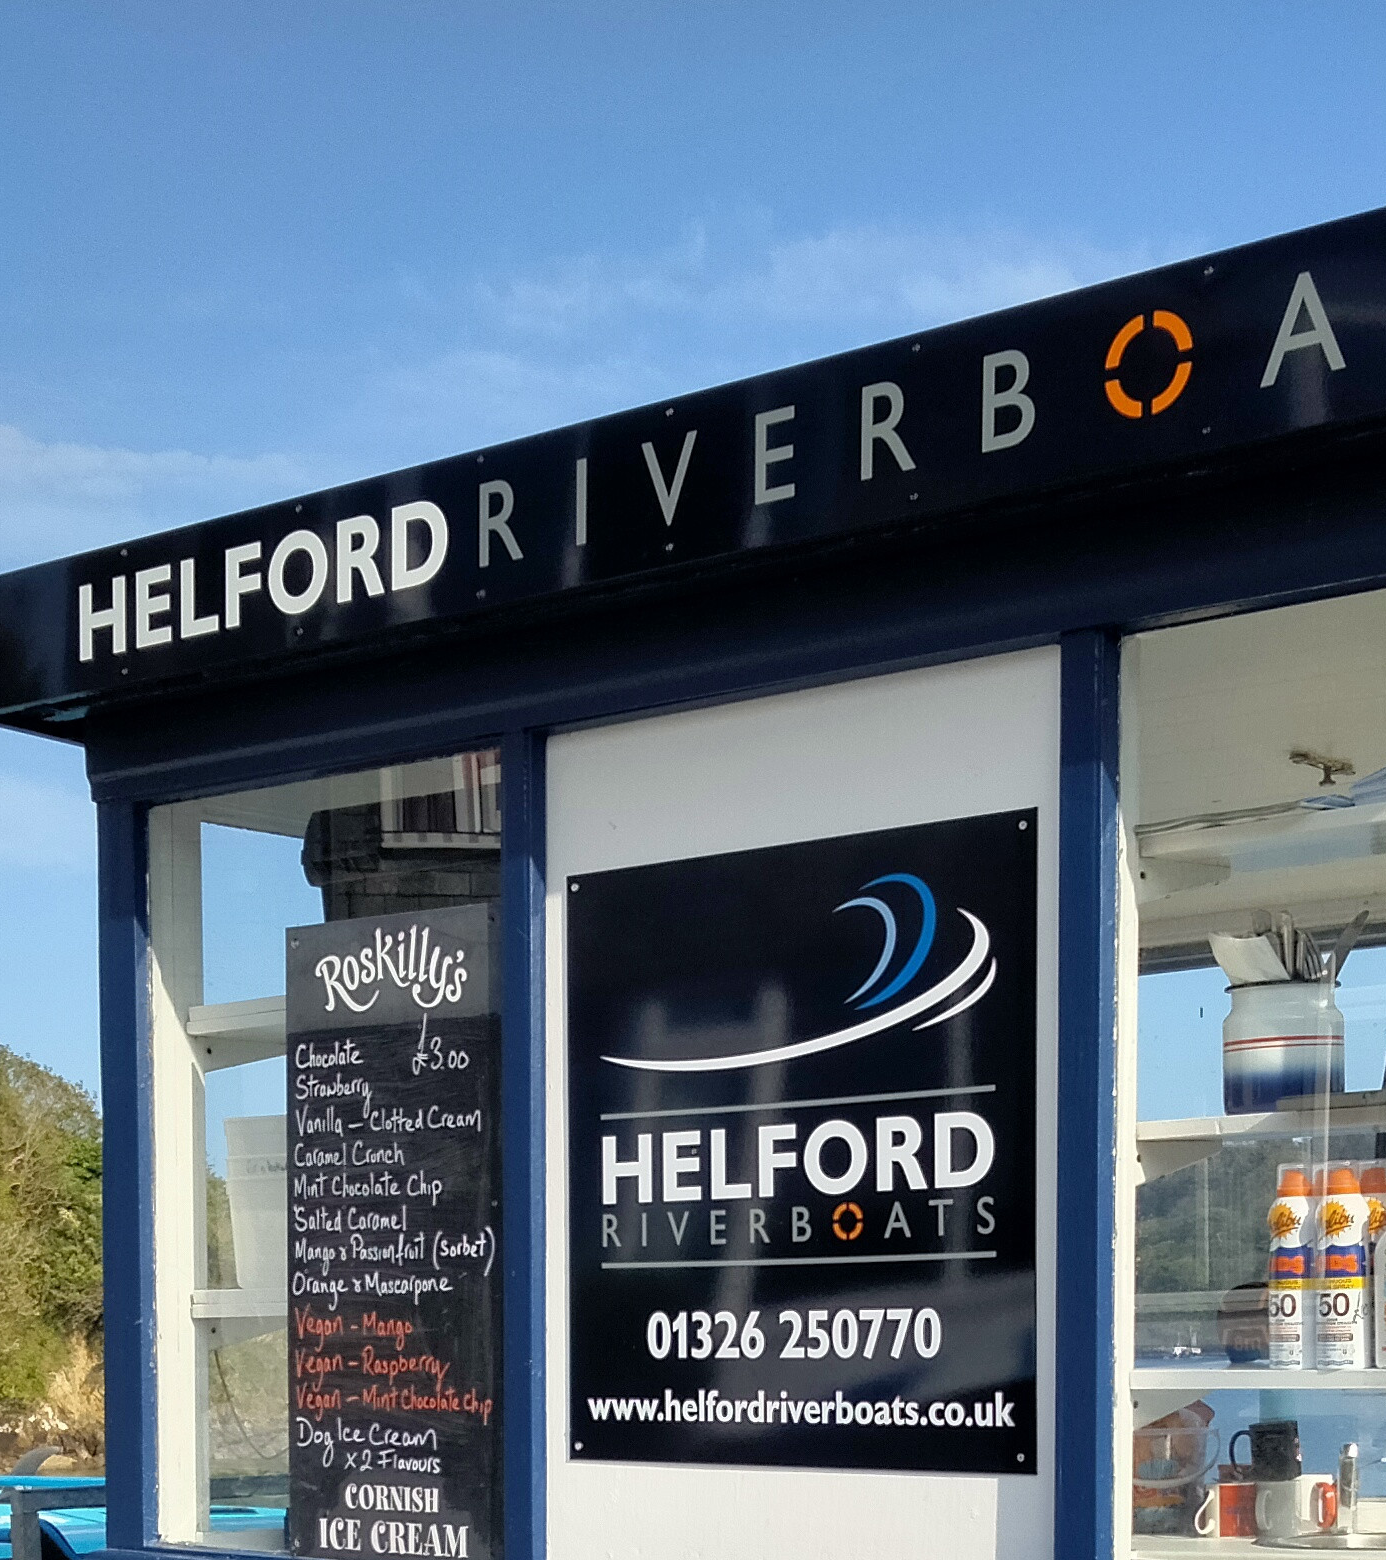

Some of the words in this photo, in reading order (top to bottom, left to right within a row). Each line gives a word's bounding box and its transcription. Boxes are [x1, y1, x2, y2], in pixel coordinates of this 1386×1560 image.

[77, 499, 450, 664] HELFORD
[315, 923, 468, 1013] Roskilly's
[295, 1038, 364, 1070] Chocolate
[295, 1074, 374, 1119] Strawberry
[295, 1105, 344, 1136] Vanilla
[370, 1108, 424, 1133] Clotted
[427, 1105, 482, 1133] Cream
[294, 1143, 347, 1168] Caramel
[601, 1111, 996, 1206] HELFORD
[294, 1173, 329, 1200] Mint
[331, 1171, 401, 1199] Chocolate
[347, 1204, 408, 1232] Caramel
[602, 1195, 997, 1248] RIVERBOATS
[294, 1238, 336, 1276] Mango
[292, 1272, 348, 1311] Orange
[1318, 1292, 1350, 1318] 50
[646, 1311, 767, 1360] 01326
[779, 1307, 942, 1360] 250770
[587, 1389, 1016, 1428] www.helfordriverboats.co.uk
[295, 1416, 335, 1469] Dog
[337, 1416, 366, 1443] Ice
[368, 1422, 438, 1451] Cream
[344, 1483, 440, 1514] CORNISH
[319, 1517, 361, 1551] ICE
[370, 1520, 469, 1559] CREAM
